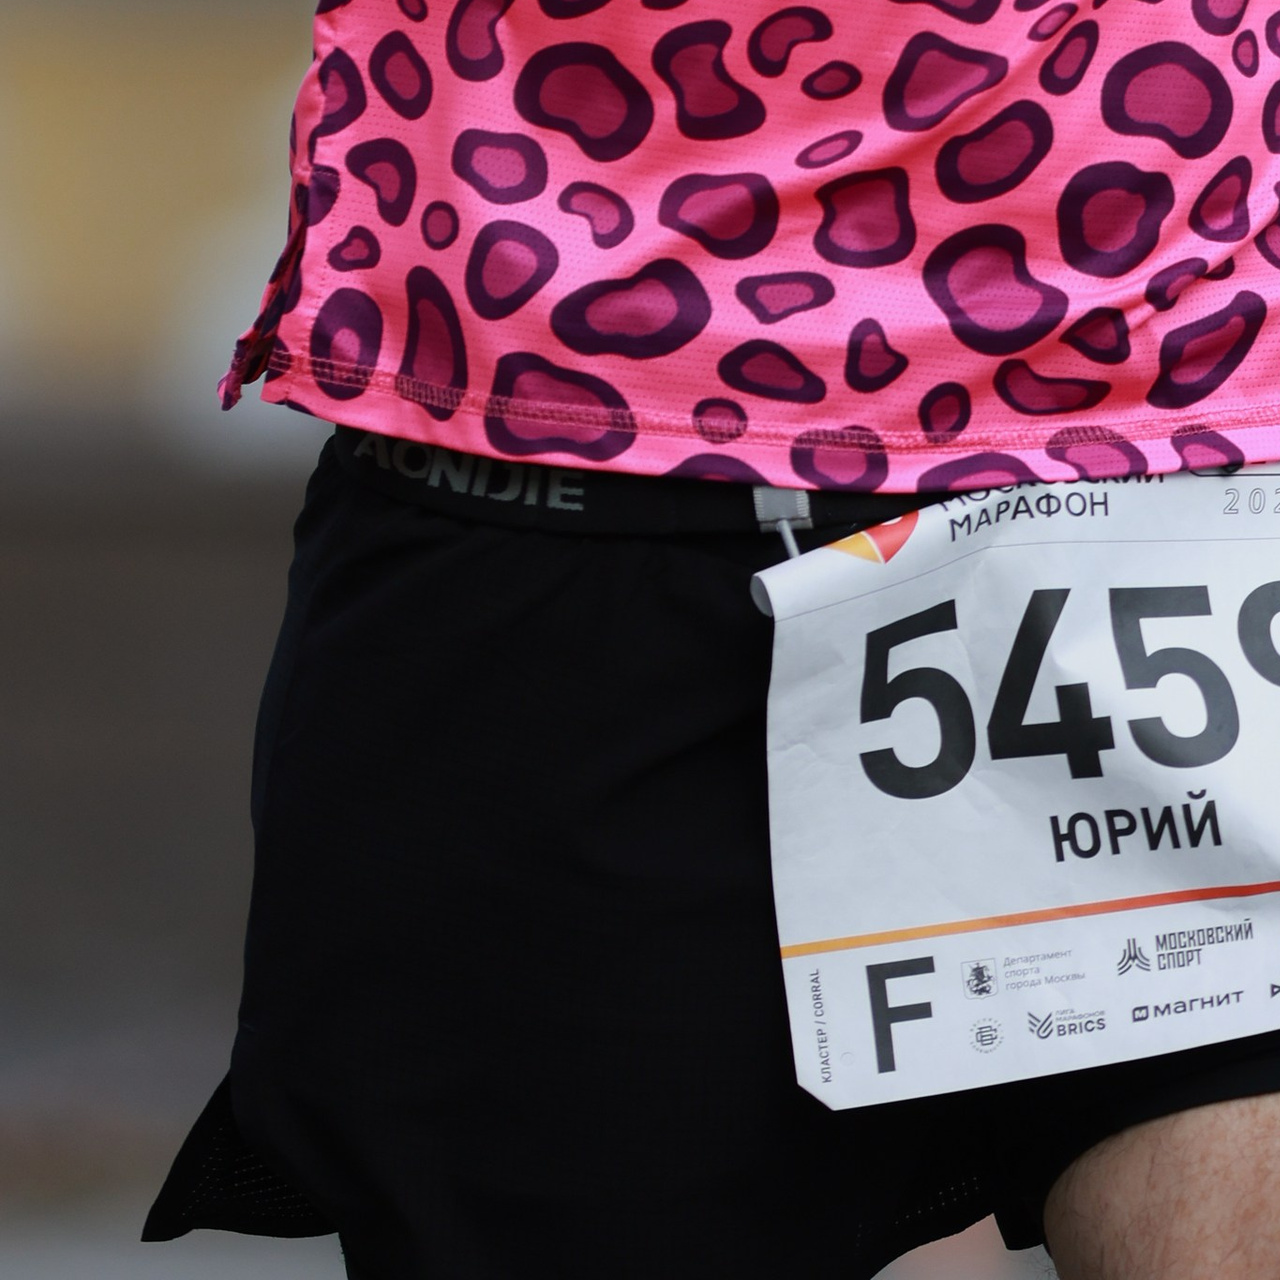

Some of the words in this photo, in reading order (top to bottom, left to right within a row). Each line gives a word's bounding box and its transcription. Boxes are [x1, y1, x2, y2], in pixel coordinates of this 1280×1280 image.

[949, 491, 1110, 542] МАРАФОН
[1050, 788, 1223, 863] ЮРИЙ
[1155, 918, 1254, 952] МОСКОВСКИЙ
[1003, 949, 1073, 968] Департамент
[1004, 966, 1041, 980] спорта
[1157, 948, 1203, 971] СПОРТ
[810, 968, 825, 1017] CORRAL
[1005, 978, 1042, 991] города
[1045, 971, 1086, 985] Москвы
[865, 956, 936, 1074] F
[1057, 1018, 1106, 1037] BRICS
[816, 1028, 832, 1083] КЛАСТЕР
